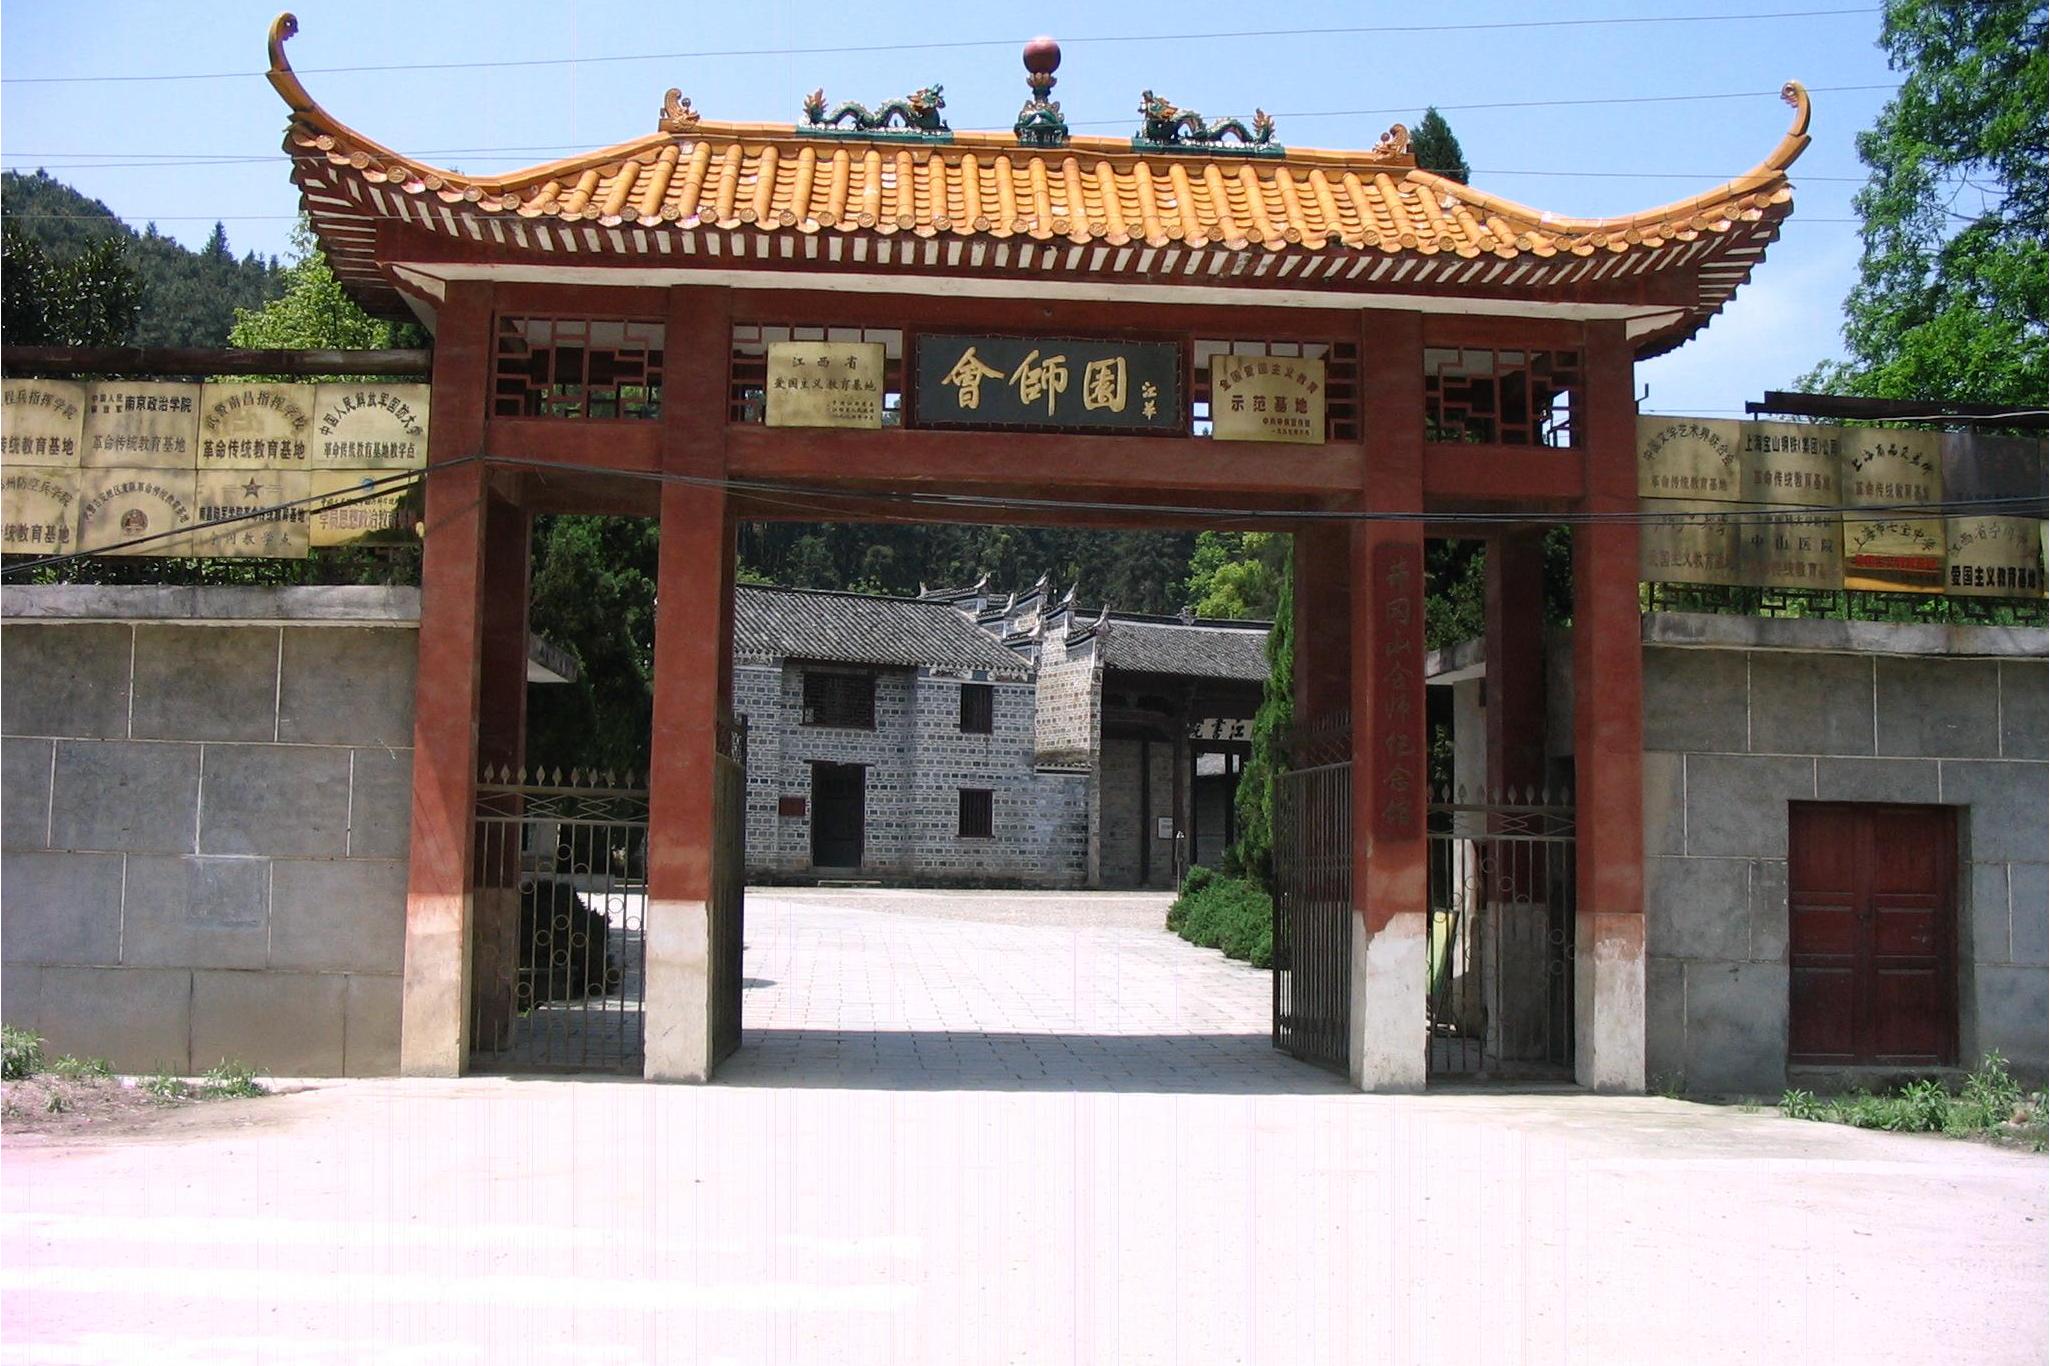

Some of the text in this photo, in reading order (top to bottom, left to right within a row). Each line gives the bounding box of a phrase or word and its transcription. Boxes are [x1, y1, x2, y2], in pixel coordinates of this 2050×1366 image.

[792, 355, 858, 370] 江西省
[774, 376, 877, 392] 爱国主义教育基地
[1231, 394, 1308, 414] 示范基地
[92, 434, 187, 453] 革命传统教育基地
[203, 439, 306, 460] 革命传统教育基地
[1950, 565, 2037, 590] 爱国主义教育基地
